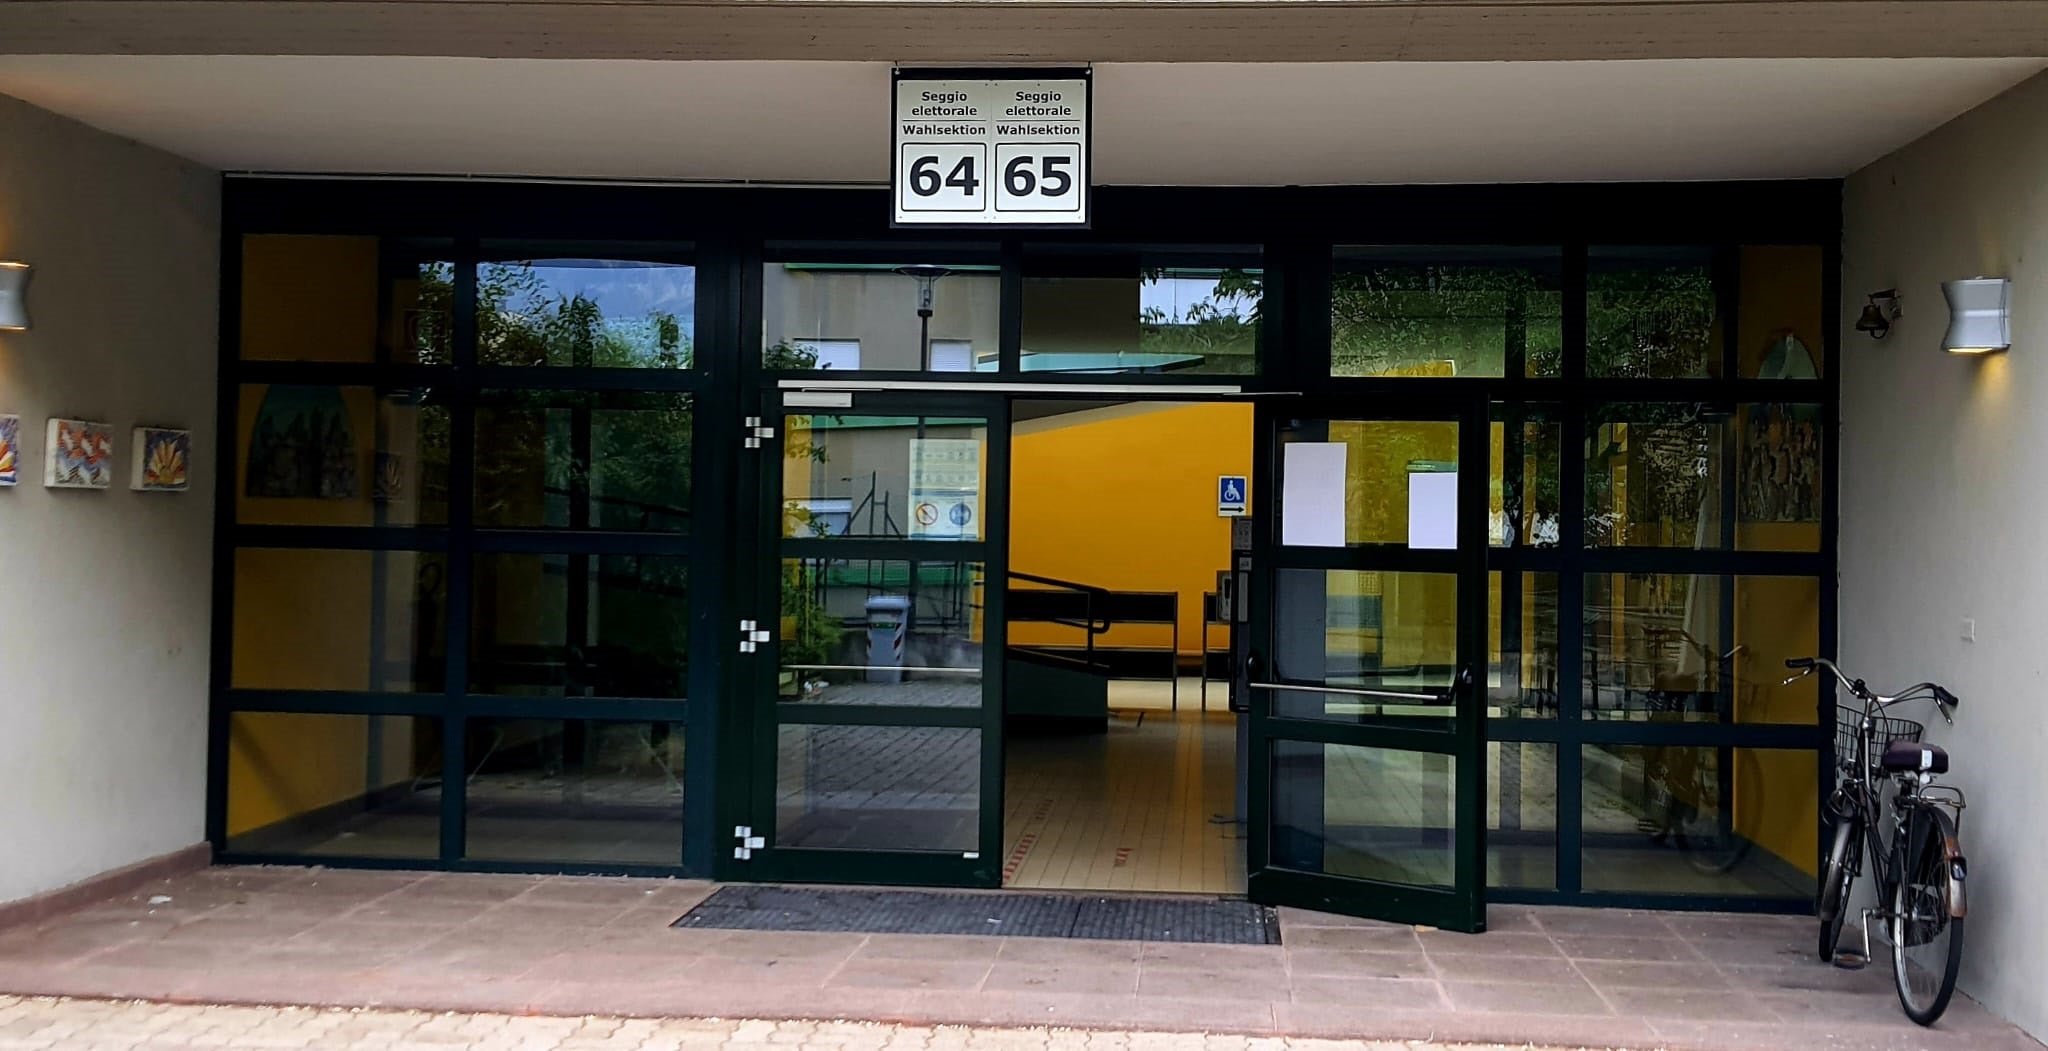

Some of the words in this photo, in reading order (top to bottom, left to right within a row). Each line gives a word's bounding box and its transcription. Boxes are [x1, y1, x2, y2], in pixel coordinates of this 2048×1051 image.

[921, 91, 968, 104] Seggio
[1015, 91, 1062, 104] Seggio
[911, 105, 978, 116] elettorale
[1005, 105, 1072, 116] elettorale
[902, 124, 986, 135] Wahlsektion
[996, 124, 1080, 135] Wahlsektion
[909, 155, 980, 197] 64
[1003, 155, 1072, 197] 65
